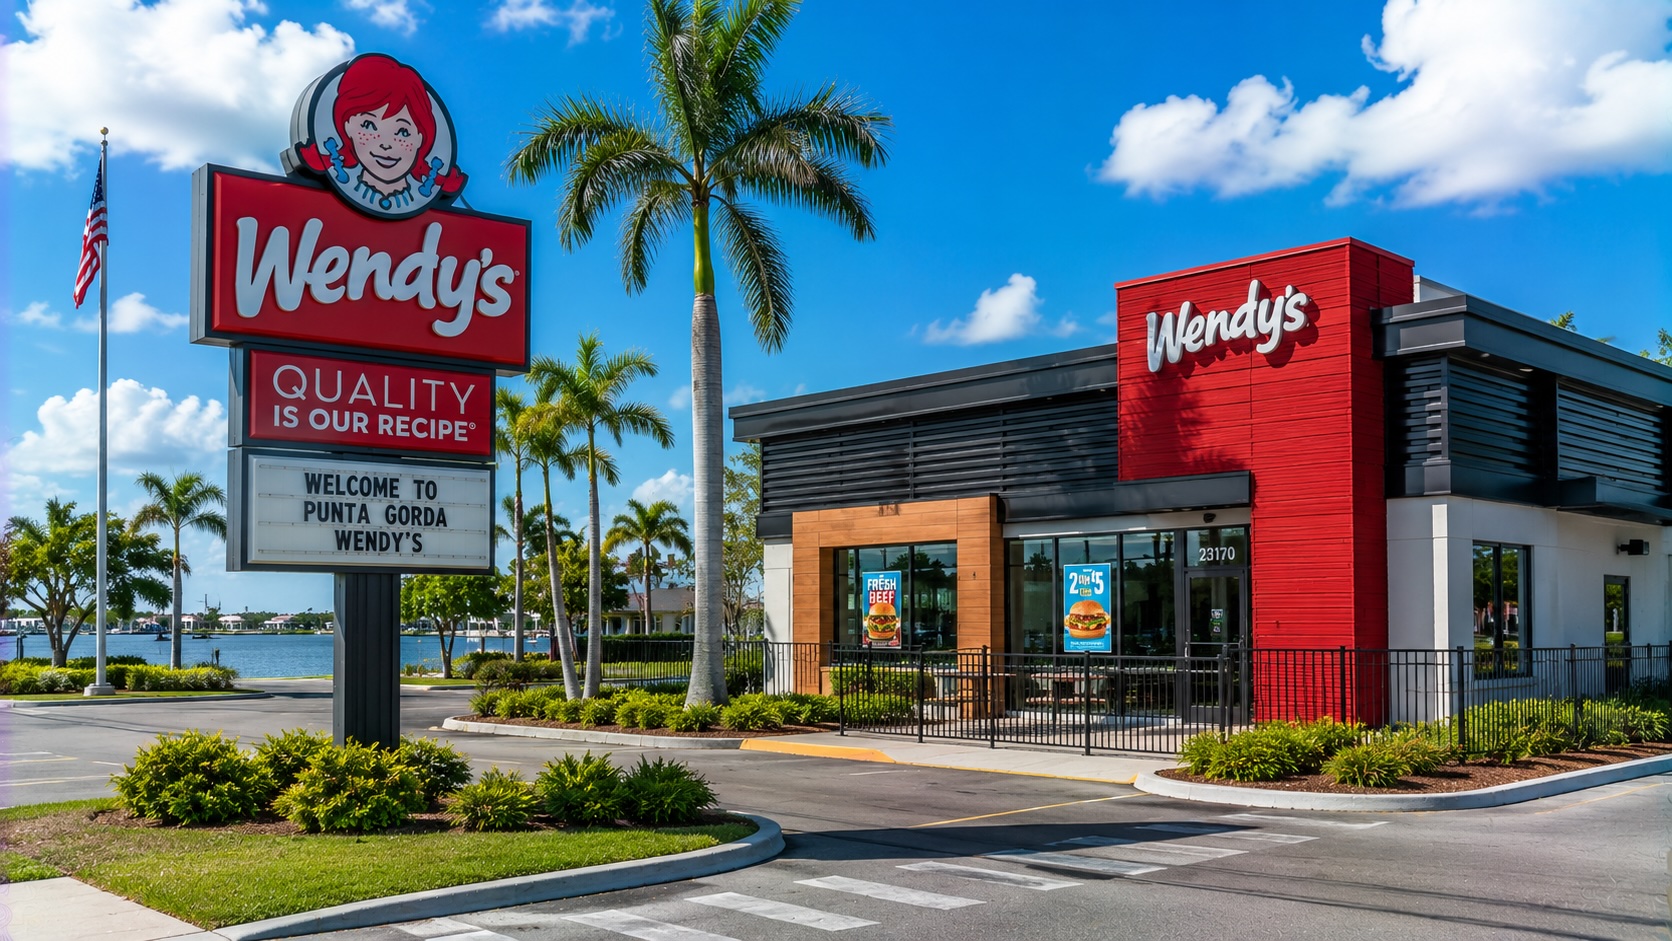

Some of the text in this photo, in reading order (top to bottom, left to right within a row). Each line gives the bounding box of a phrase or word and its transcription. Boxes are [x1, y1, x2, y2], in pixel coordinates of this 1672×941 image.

[235, 216, 516, 337] Wendy's
[1146, 279, 1309, 373] Wendy's
[272, 364, 475, 415] QUALITY
[273, 404, 299, 428] IS
[308, 408, 369, 434] OUR
[304, 472, 438, 500] WELCOME TO
[303, 501, 448, 528] PUNTA GORDA
[334, 529, 423, 553] WENDY'S
[1199, 546, 1236, 562] 23170
[867, 578, 896, 591] FRESH
[869, 590, 895, 603] BEEF
[1069, 572, 1079, 594] 2
